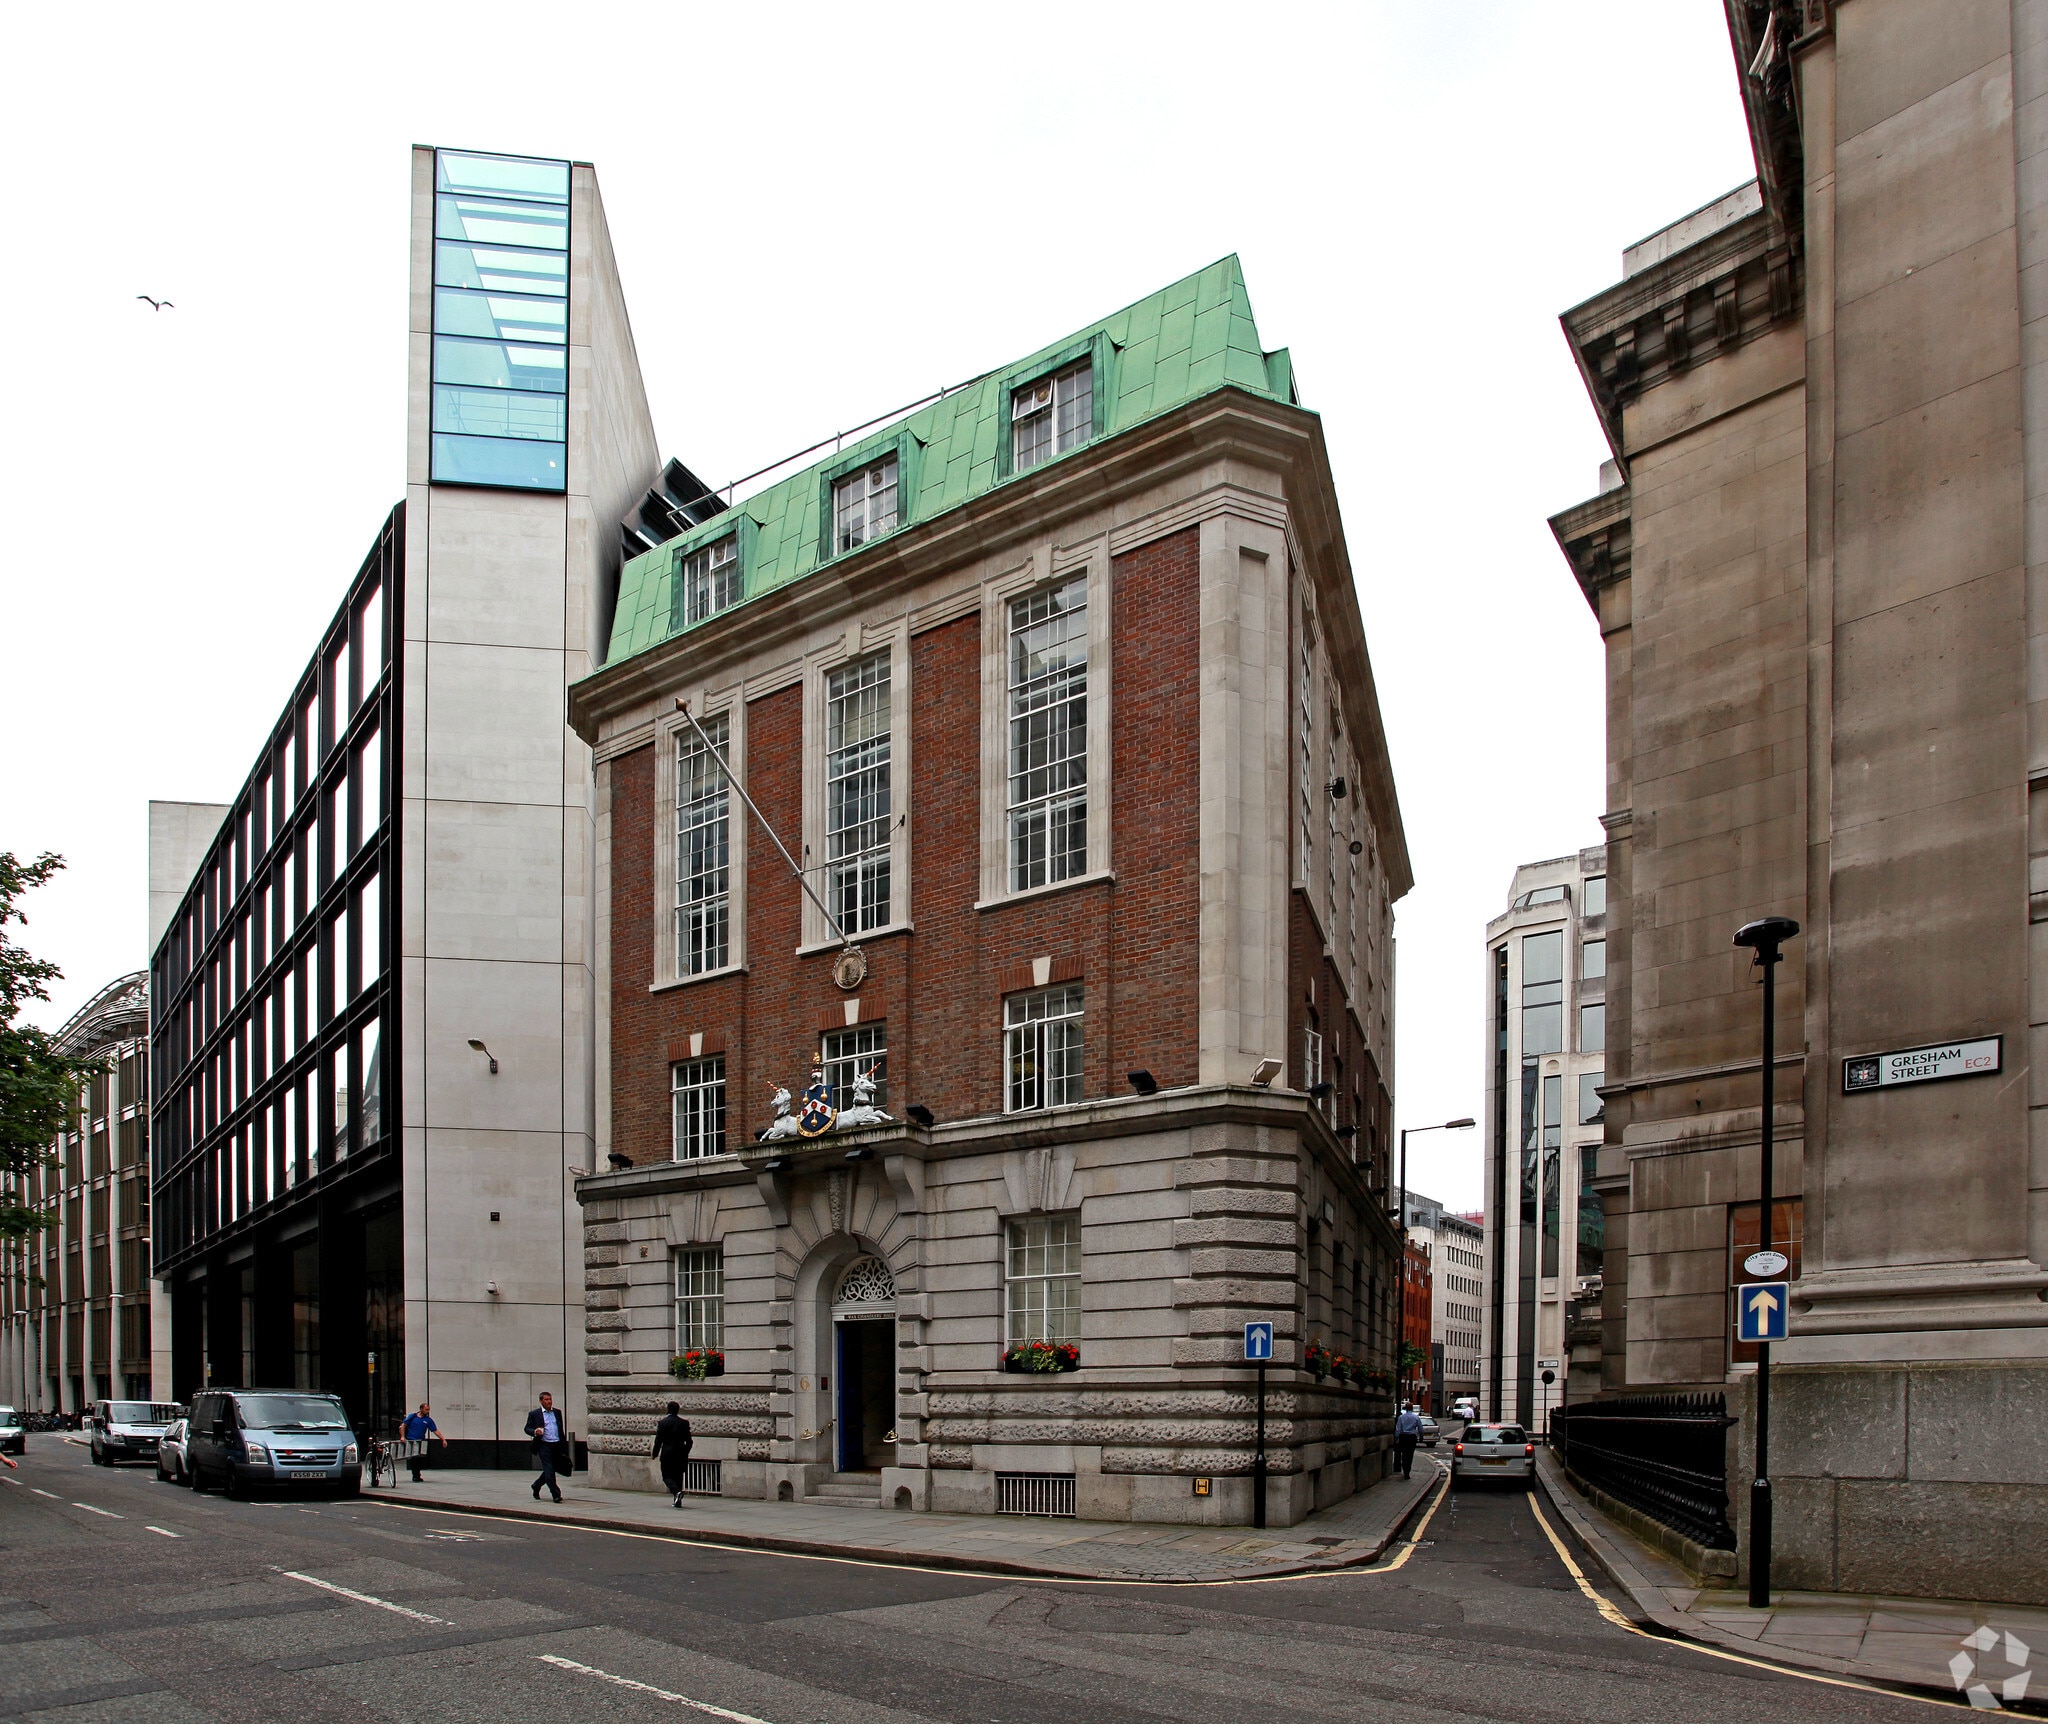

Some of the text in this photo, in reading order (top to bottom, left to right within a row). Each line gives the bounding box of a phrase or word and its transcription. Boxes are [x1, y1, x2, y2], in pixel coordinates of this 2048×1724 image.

[1892, 1048, 1961, 1067] GRESHAM
[1891, 1057, 1991, 1079] STREET EC2
[1746, 1254, 1758, 1262] City
[1773, 1252, 1785, 1260] Zone
[800, 1375, 810, 1391] 6
[1197, 1480, 1208, 1493] H
